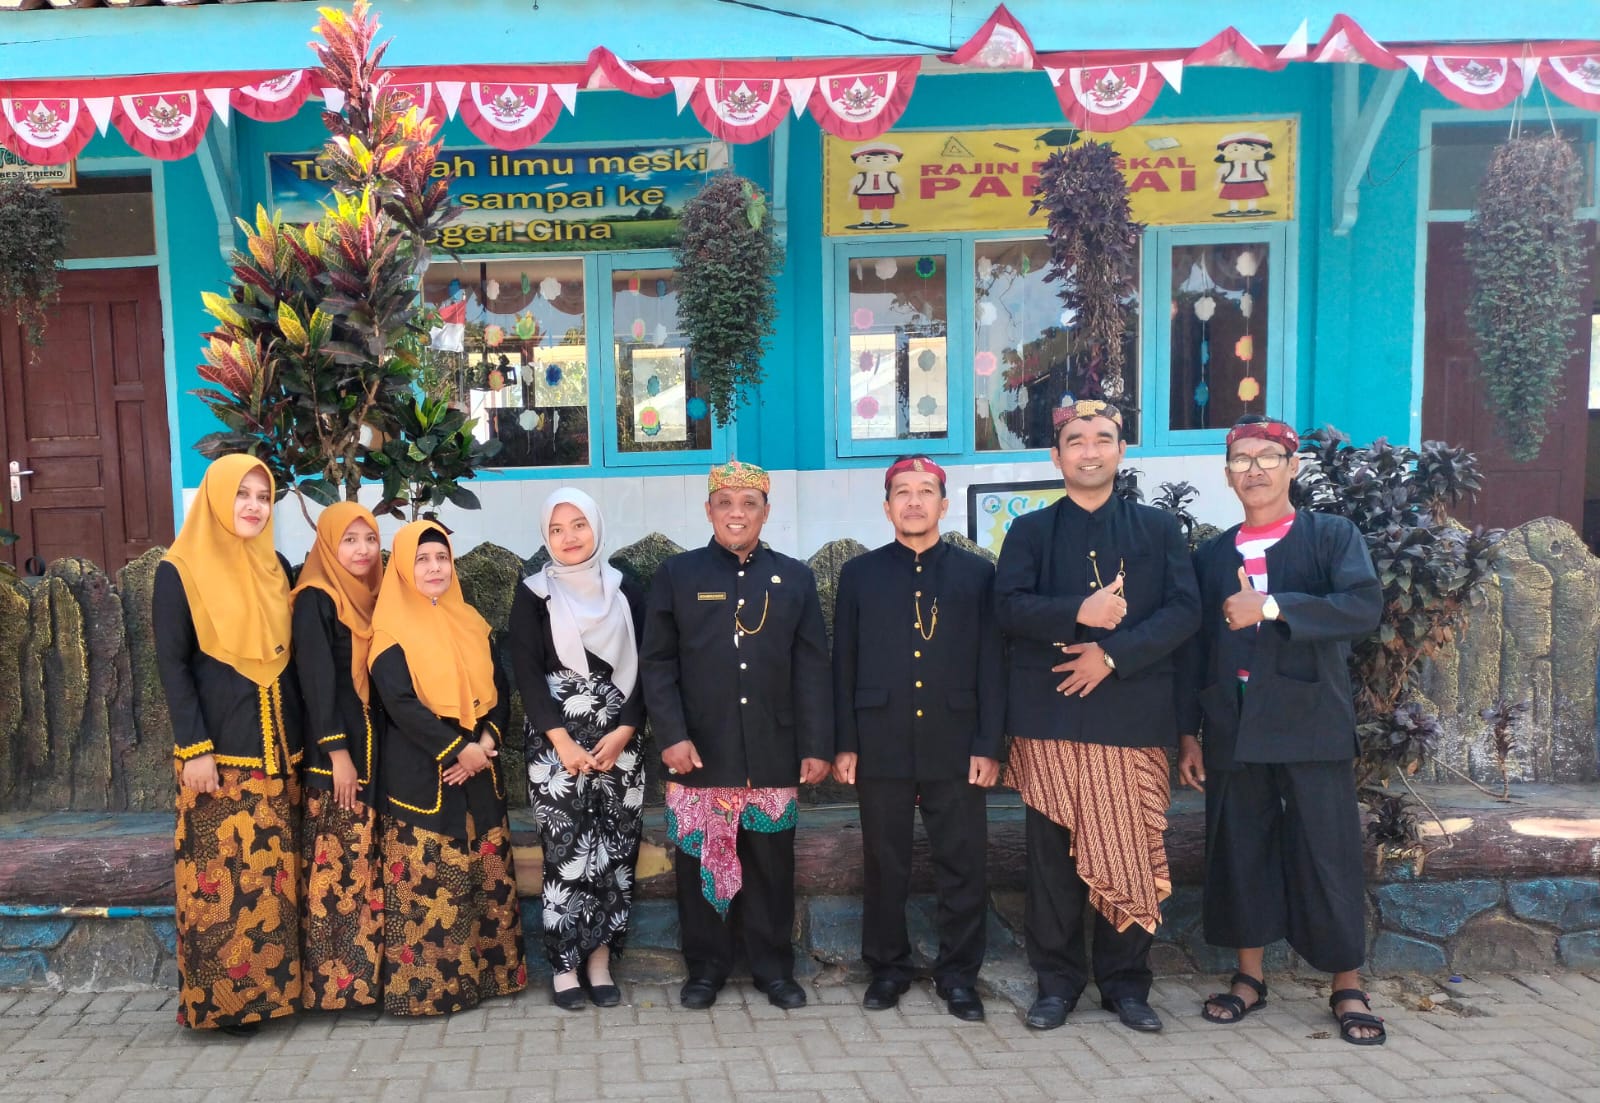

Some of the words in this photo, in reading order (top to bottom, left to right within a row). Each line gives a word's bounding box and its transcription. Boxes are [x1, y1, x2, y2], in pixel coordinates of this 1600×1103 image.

[490, 154, 573, 177] ilmu
[589, 149, 708, 174] meski
[920, 162, 1019, 176] RAJIN
[919, 169, 1196, 199] PAAI
[459, 186, 604, 213] sampai
[619, 185, 665, 206] ke
[425, 221, 513, 248] geri
[527, 219, 612, 242] Cina
